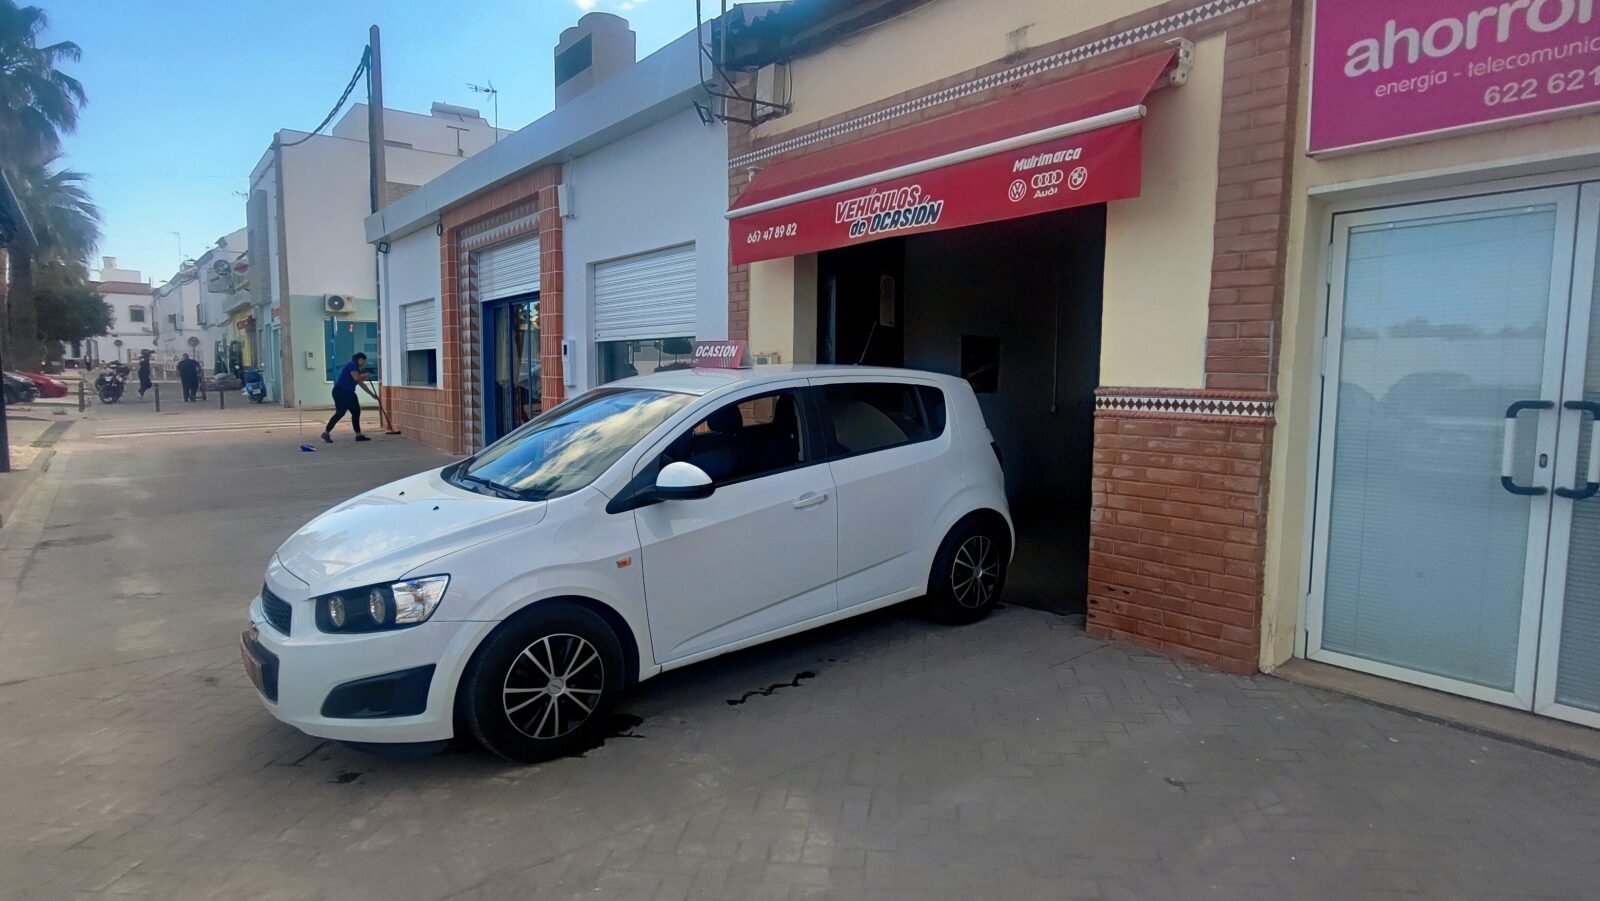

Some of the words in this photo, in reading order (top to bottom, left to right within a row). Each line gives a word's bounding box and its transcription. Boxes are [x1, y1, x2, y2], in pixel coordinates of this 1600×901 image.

[1484, 79, 1538, 107] 622
[1547, 68, 1600, 94] 621
[836, 185, 921, 223] VEHÍCULOS
[1033, 187, 1058, 199] Audi
[763, 227, 774, 240] 47
[774, 225, 785, 238] 89
[785, 222, 797, 236] 82
[849, 218, 867, 238] de
[868, 195, 944, 234] OCASIÓN
